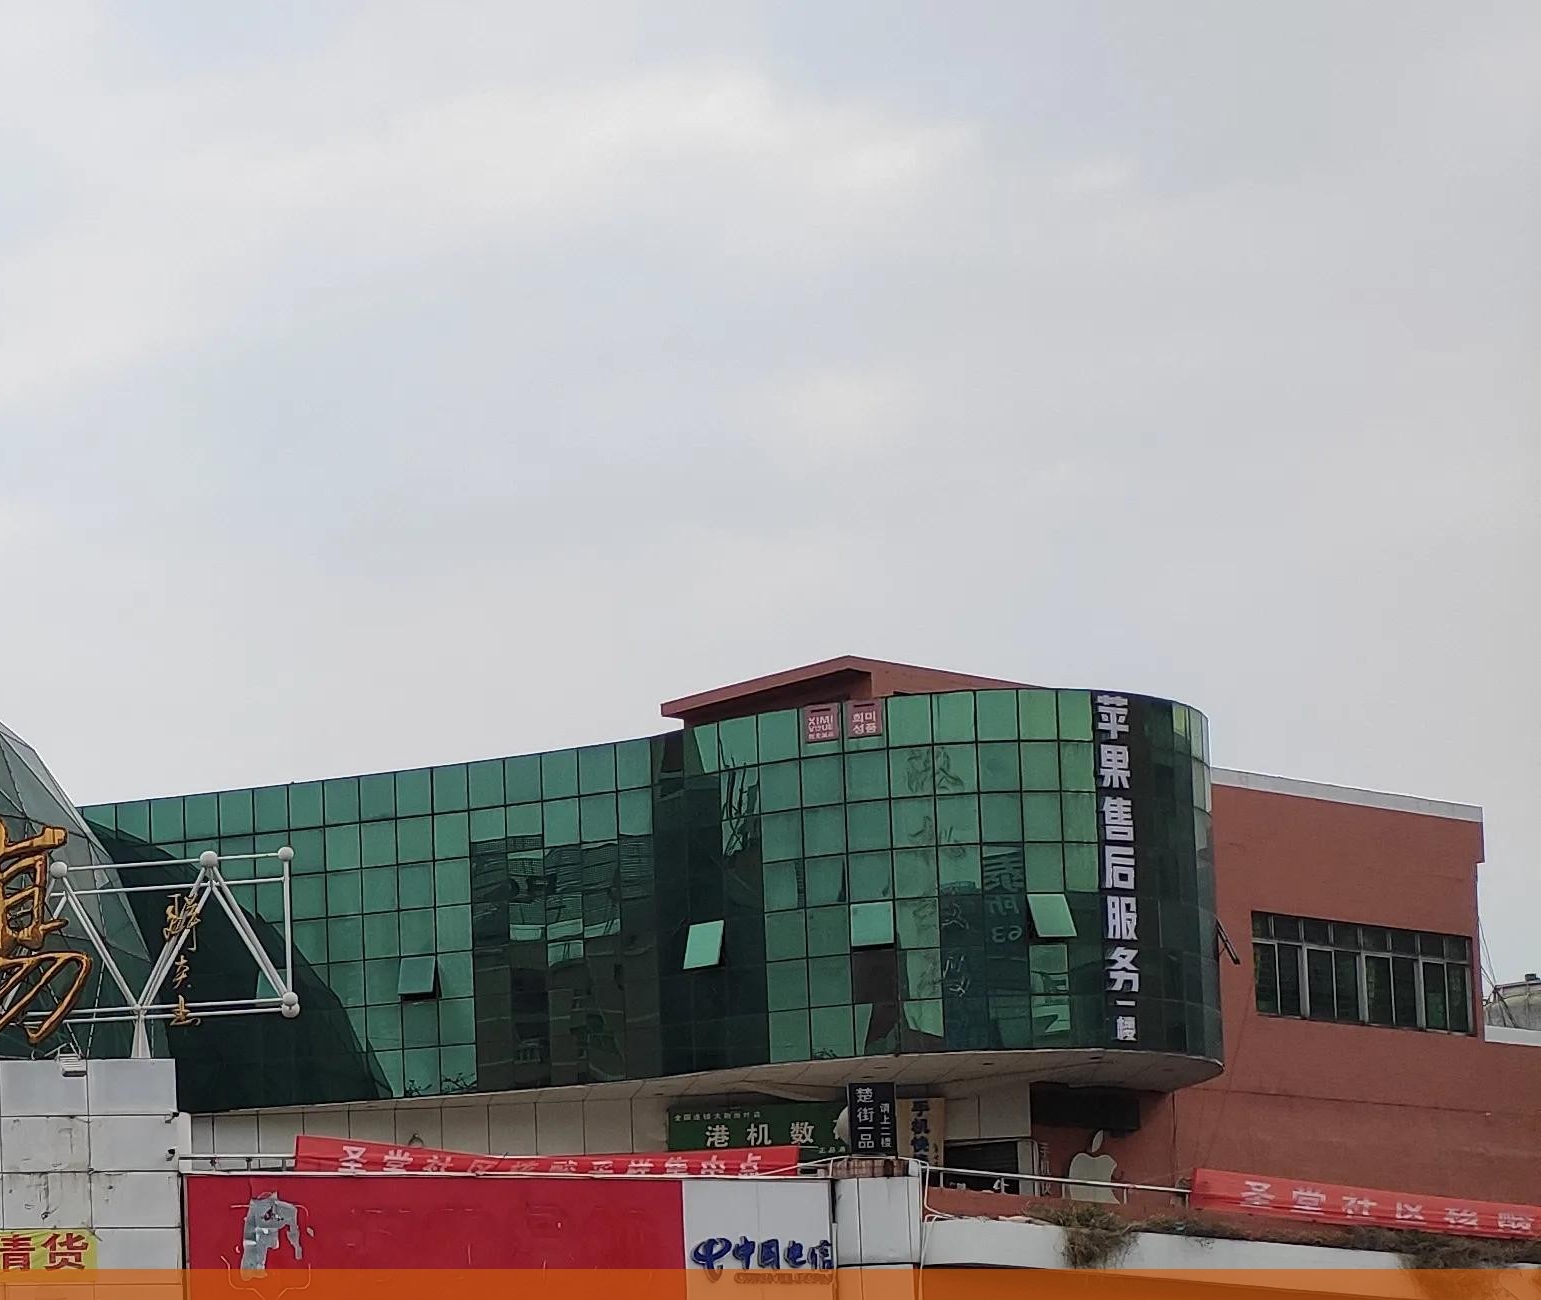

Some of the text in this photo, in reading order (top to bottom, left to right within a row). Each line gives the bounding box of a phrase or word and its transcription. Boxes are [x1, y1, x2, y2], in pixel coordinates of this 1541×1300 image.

[1096, 695, 1140, 992] 苹果售后服务
[705, 1121, 841, 1148] 港机数
